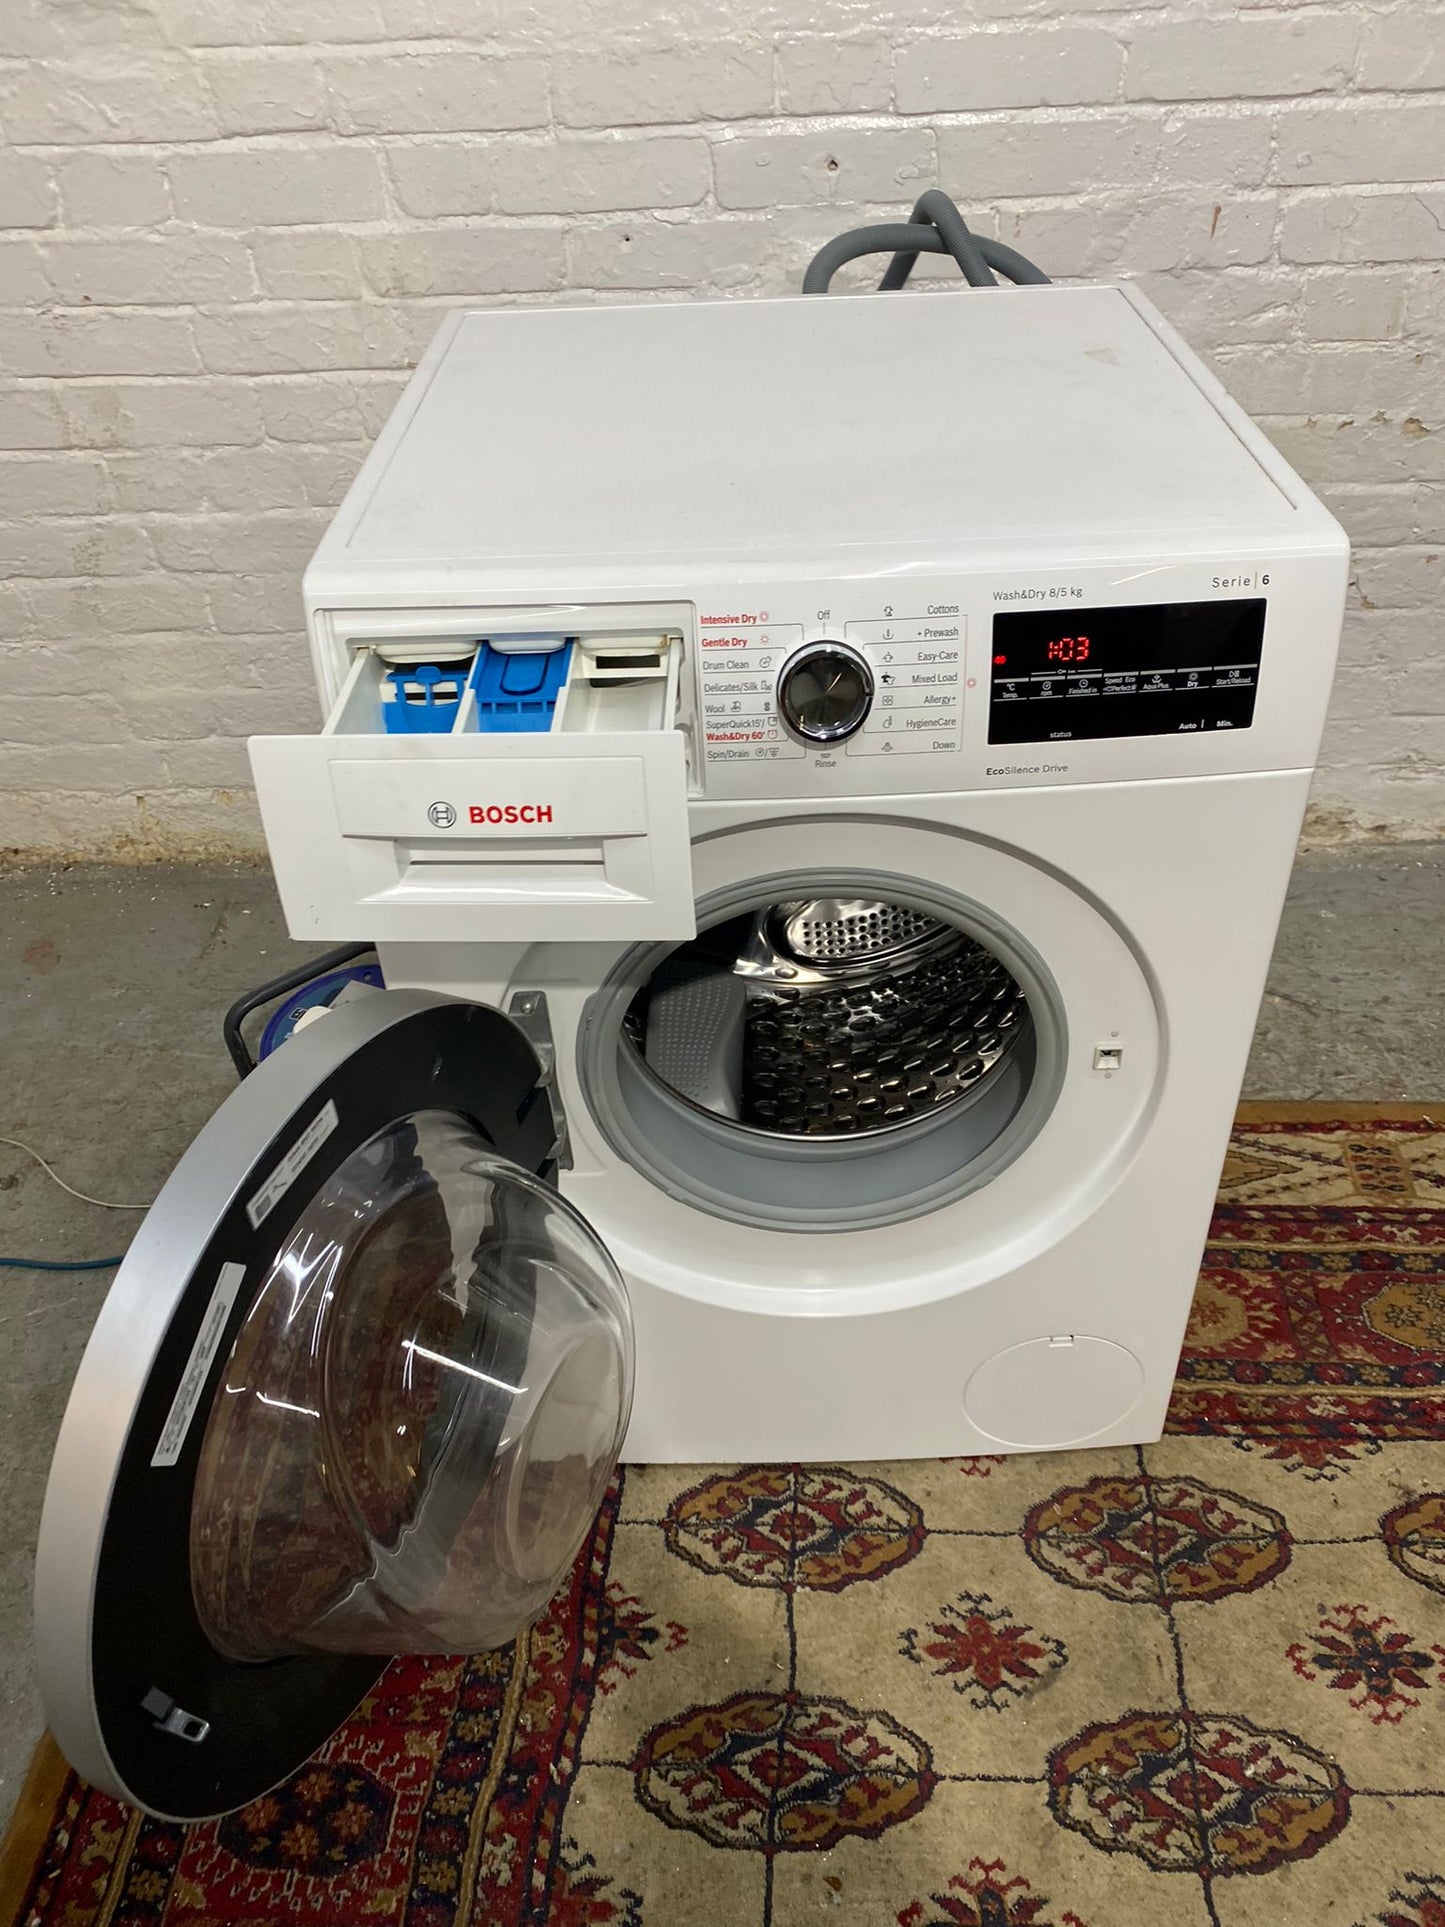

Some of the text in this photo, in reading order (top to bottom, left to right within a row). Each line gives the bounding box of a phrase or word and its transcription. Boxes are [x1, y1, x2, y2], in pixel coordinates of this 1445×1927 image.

[1212, 574, 1270, 588] Serie 6
[993, 586, 1083, 602] Wash&Dry 8/5 kg
[927, 604, 960, 615] Cottons
[700, 613, 757, 626] Intensive Dry
[817, 610, 831, 621] Off
[924, 626, 959, 638] Prewash
[701, 637, 748, 648] Gentle Dry
[1048, 637, 1089, 660] 1:03
[917, 650, 958, 662] Easy-Care
[703, 659, 749, 670] Drum Clean
[912, 672, 958, 684] Mixed Load
[1105, 677, 1122, 685] Speed
[704, 680, 758, 693] Delicates/Silk
[705, 703, 726, 713] Wool
[906, 717, 957, 729] HygieneCare
[706, 731, 750, 742] Wash&Dry
[1049, 730, 1073, 739] status
[932, 741, 956, 750] Down
[708, 749, 749, 760] Spin/Drain
[815, 759, 837, 768] Rinse
[986, 763, 1069, 776] EcoSilence Drive
[469, 805, 553, 824] BOSCH
